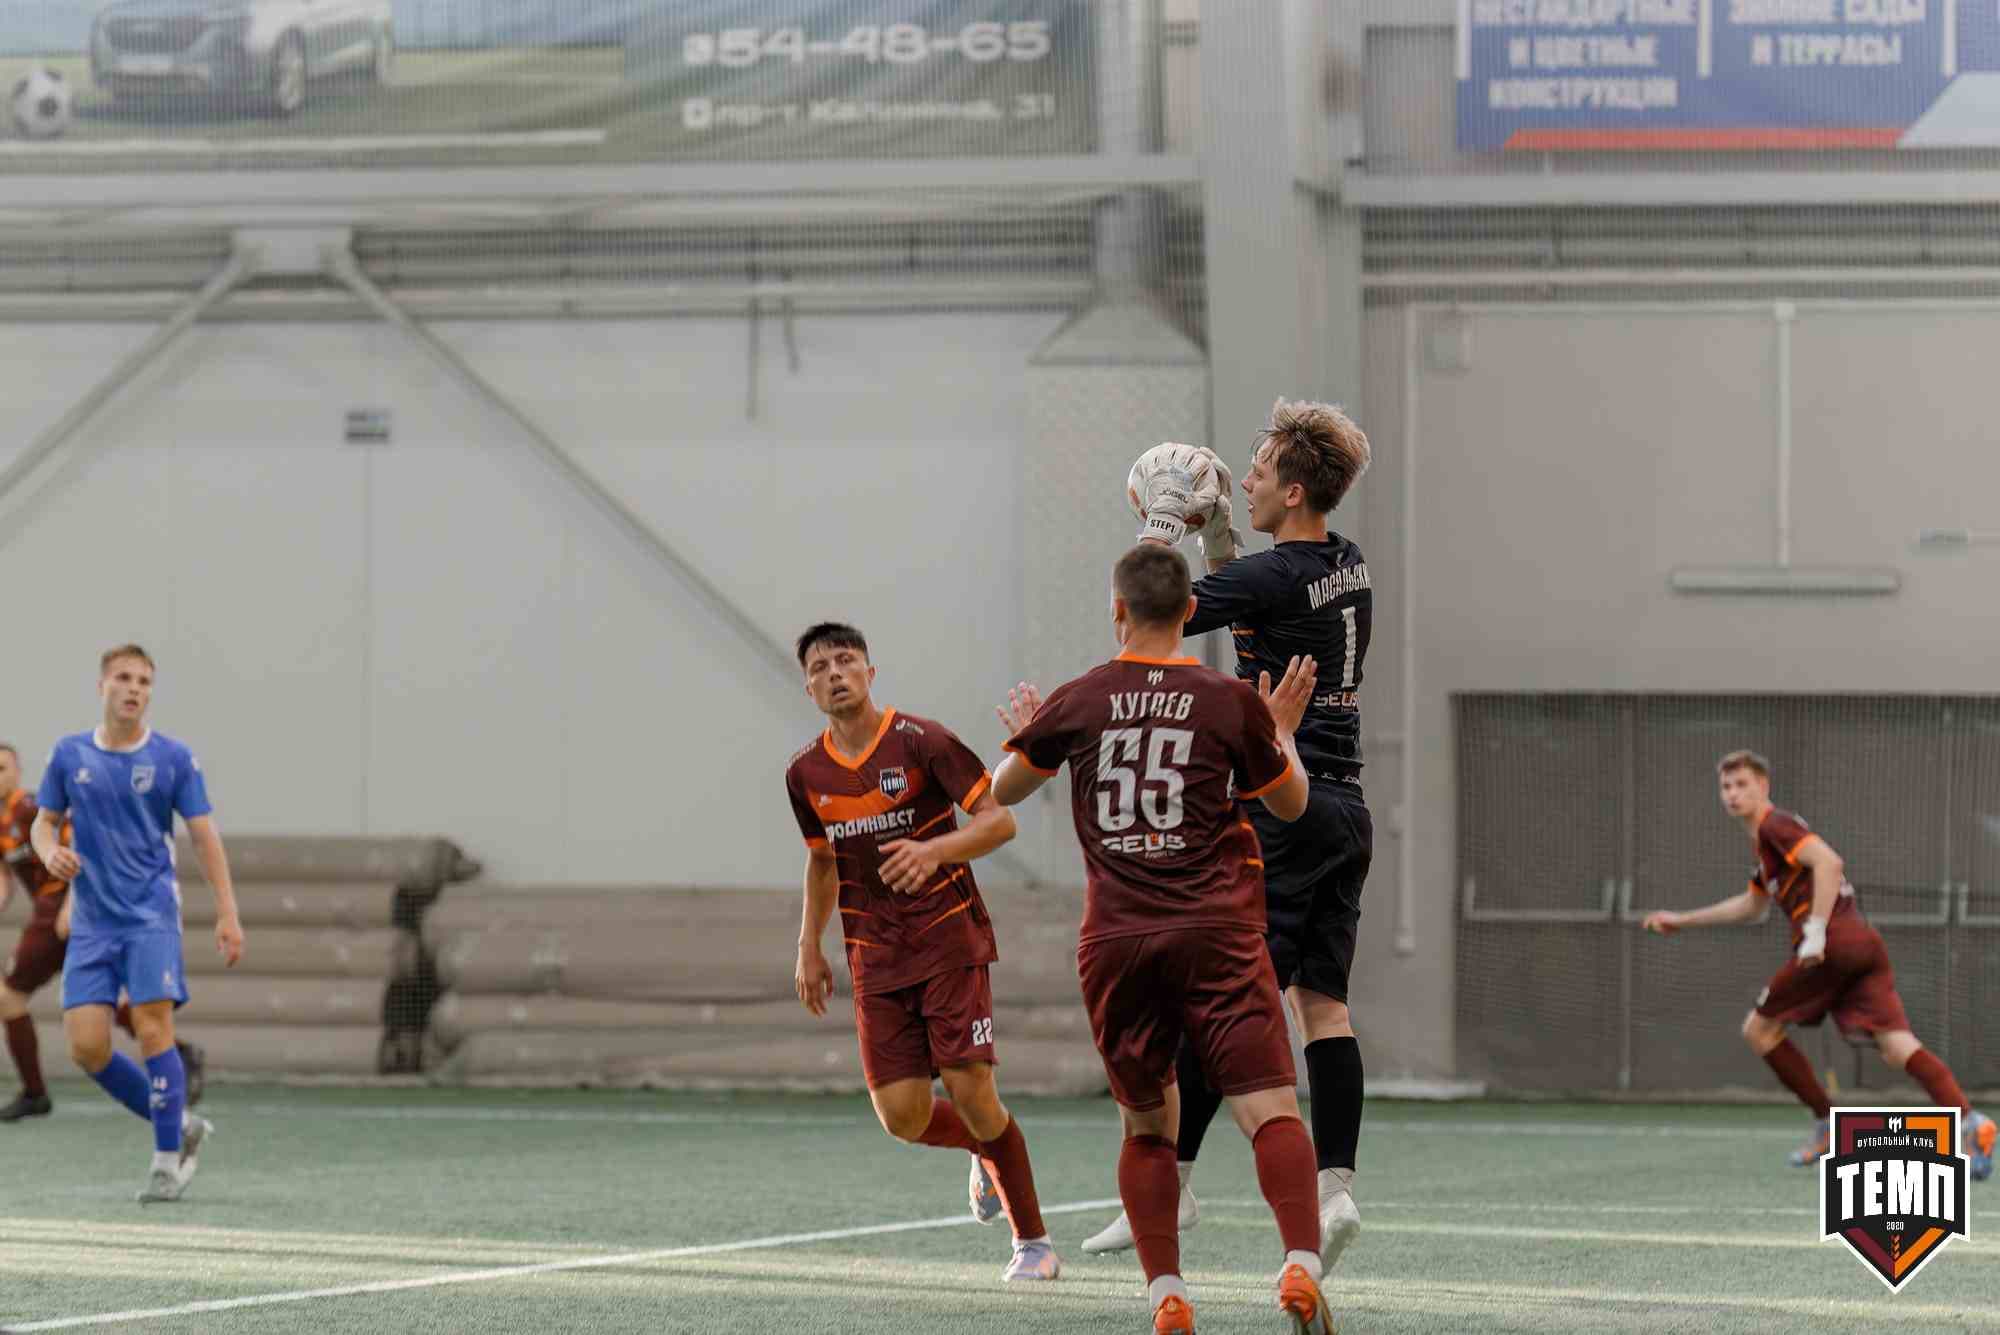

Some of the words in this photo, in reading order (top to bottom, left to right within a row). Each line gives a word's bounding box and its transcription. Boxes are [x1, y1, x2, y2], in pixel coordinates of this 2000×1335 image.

[1341, 606, 1356, 687] 1
[1109, 691, 1194, 721] ХУГАЕВ
[1096, 727, 1194, 832] 55
